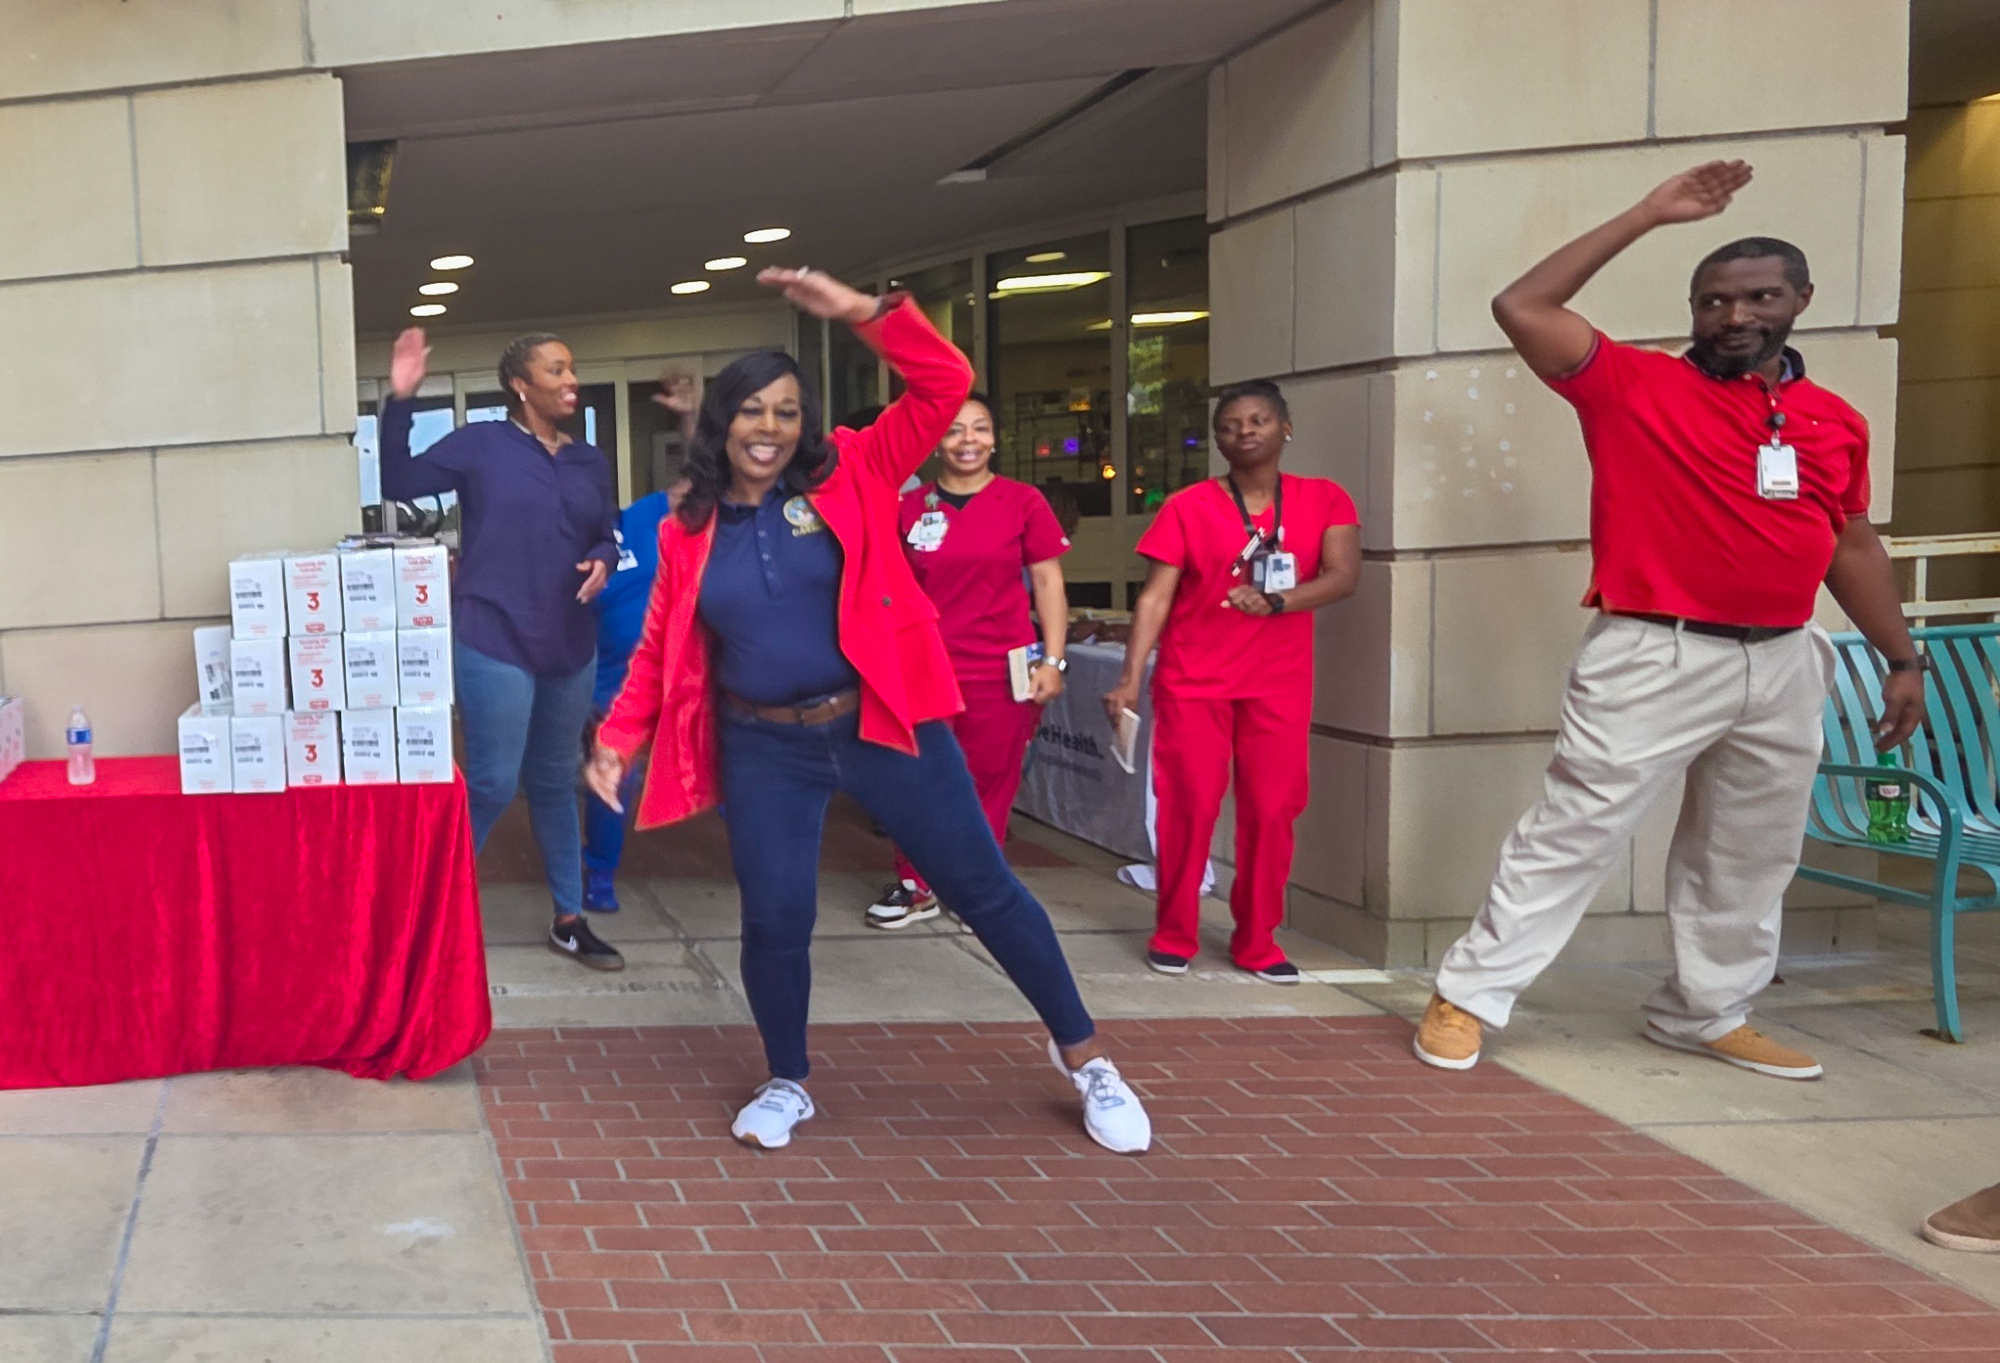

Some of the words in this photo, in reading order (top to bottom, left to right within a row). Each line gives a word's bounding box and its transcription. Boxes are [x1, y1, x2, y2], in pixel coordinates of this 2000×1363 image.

[306, 591, 320, 611] 3
[415, 584, 429, 605] 3
[311, 668, 324, 688] 3
[304, 743, 318, 763] 3
